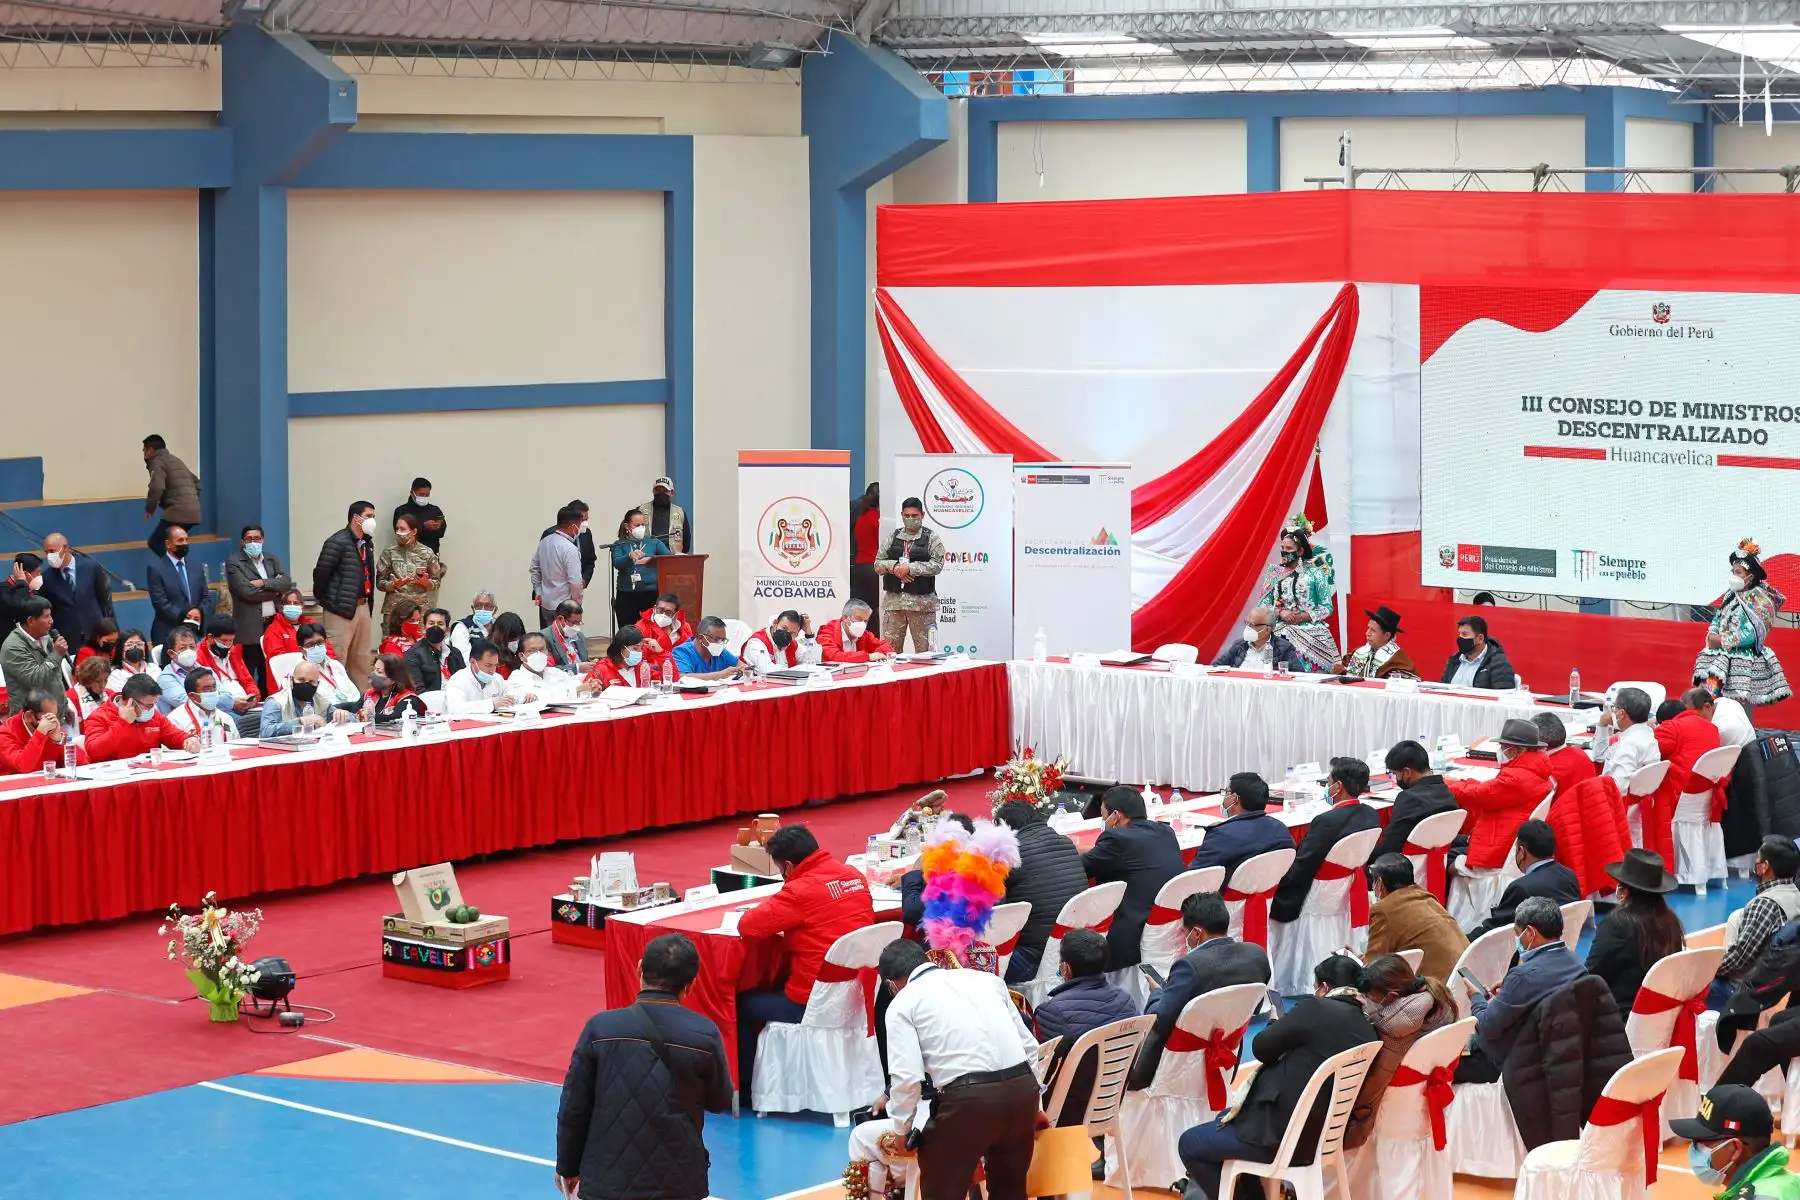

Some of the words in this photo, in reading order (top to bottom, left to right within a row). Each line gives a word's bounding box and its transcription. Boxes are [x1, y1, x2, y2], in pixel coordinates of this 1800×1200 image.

[1609, 324, 1662, 338] Gobierno
[1666, 326, 1684, 338] del
[1688, 326, 1714, 339] Perú
[1521, 395, 1543, 412] III
[1548, 396, 1643, 416] CONSEJO
[1649, 400, 1676, 418] DE
[1557, 419, 1769, 446] DESCENTRALIZADO
[1610, 447, 1713, 467] Huancavelica
[1024, 545, 1121, 556] Descentralización
[945, 551, 989, 564] CAVELICA
[1460, 553, 1480, 563] PERÚ
[1599, 555, 1647, 572] Siempre
[1615, 569, 1647, 581] pueblo
[756, 580, 820, 588] MUNICIPALIDAD
[821, 580, 833, 588] DE
[753, 587, 837, 599] ACOBAMBA
[942, 605, 957, 614] Díaz
[940, 615, 957, 623] Abad
